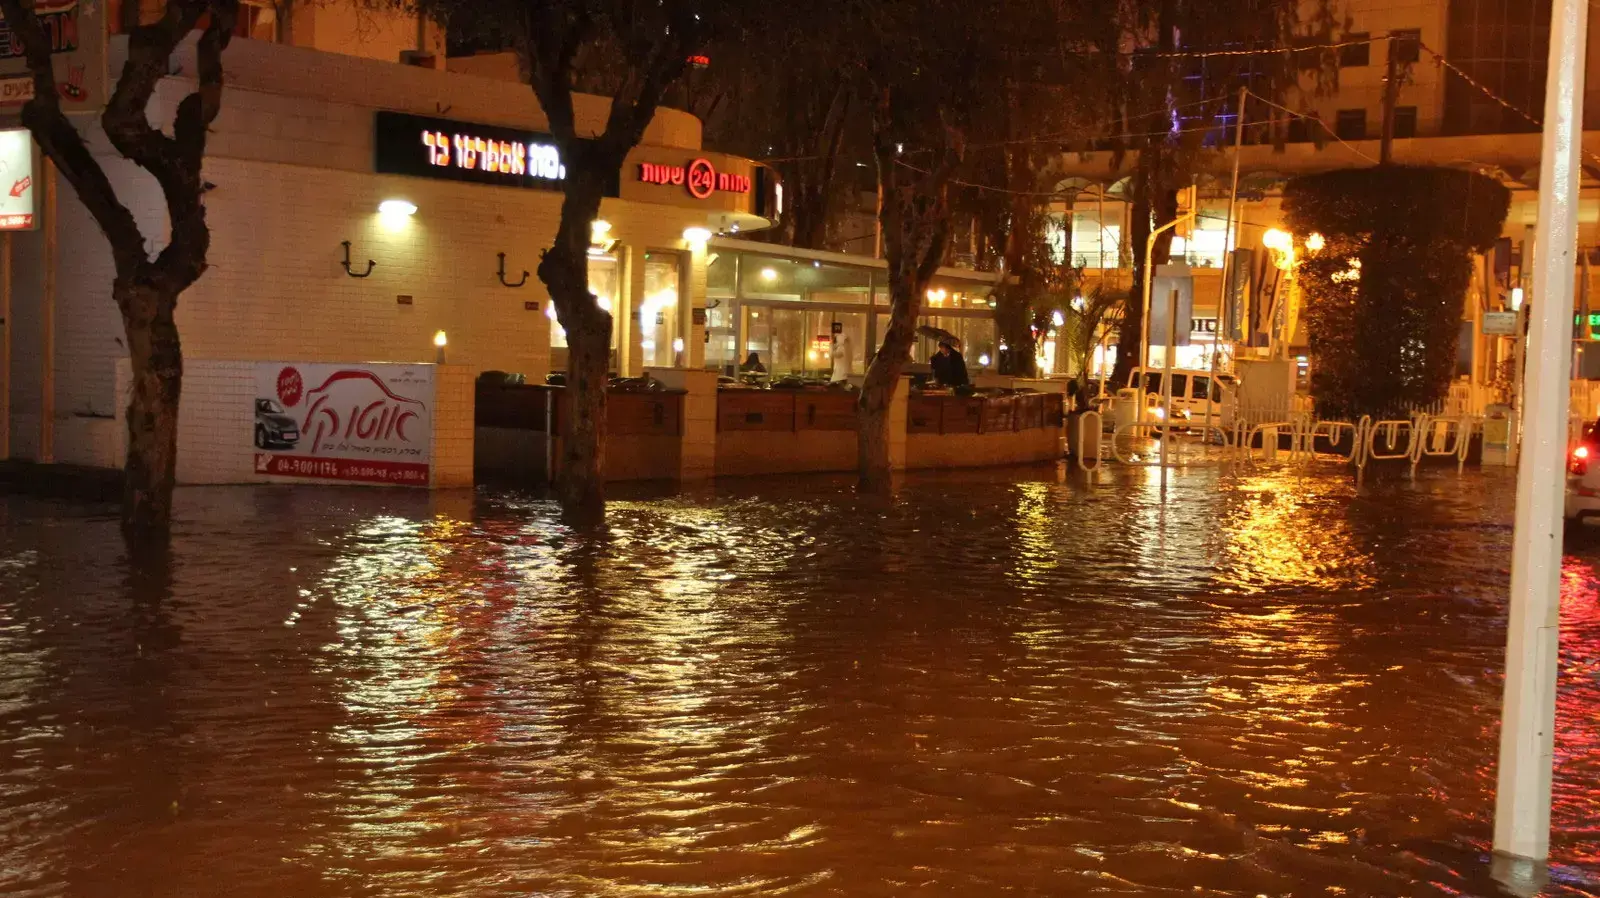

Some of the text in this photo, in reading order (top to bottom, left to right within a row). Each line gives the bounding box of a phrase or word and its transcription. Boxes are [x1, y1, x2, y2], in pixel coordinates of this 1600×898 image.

[421, 130, 450, 166] בר
[639, 162, 752, 193] פתוח 24 שעות
[301, 394, 420, 454] אוטו קל
